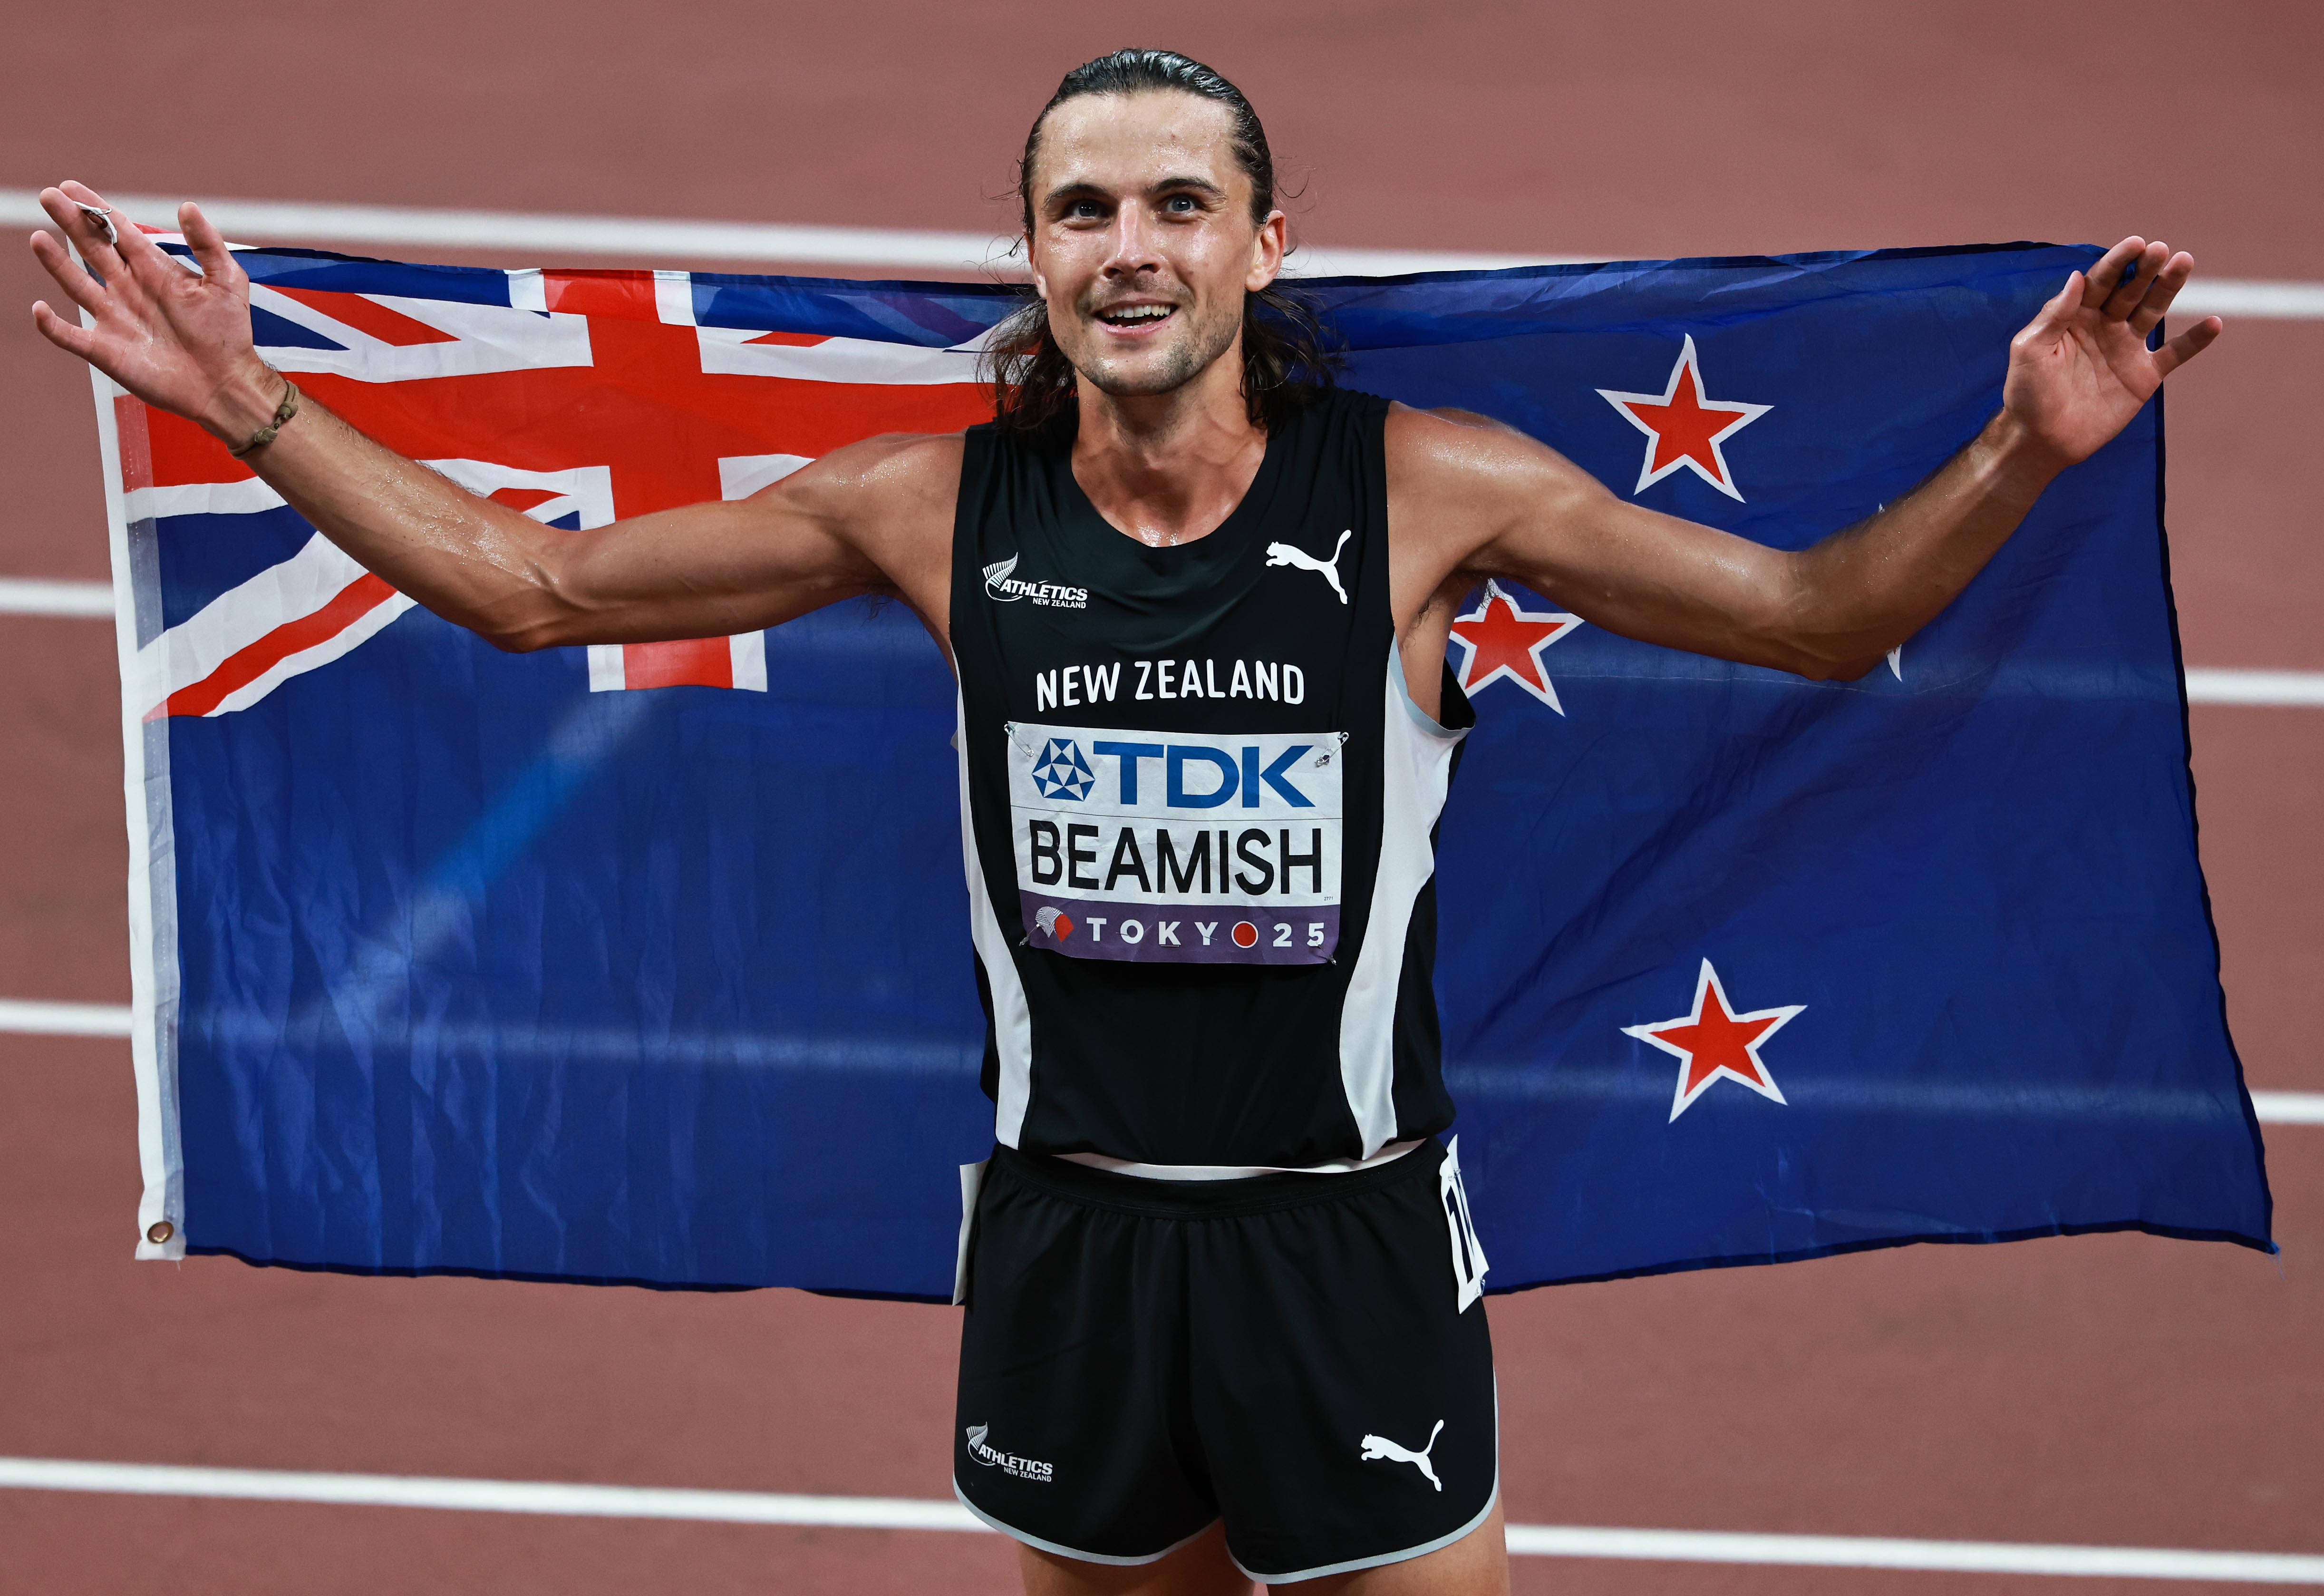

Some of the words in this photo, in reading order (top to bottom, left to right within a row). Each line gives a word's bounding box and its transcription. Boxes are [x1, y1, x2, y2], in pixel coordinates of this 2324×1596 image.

[999, 579, 1088, 601] ATHLETICS
[1033, 597, 1050, 605] NEW
[1051, 599, 1086, 609] ZEALAND
[1036, 662, 1121, 712] NEW
[1134, 659, 1304, 705] ZEALAND
[1093, 740, 1316, 808] TDK
[1029, 819, 1322, 895] BEAMISH
[1273, 922, 1325, 947] 25
[978, 1444, 1053, 1475] ATHLETICS
[1004, 1466, 1018, 1476] NEW
[1020, 1470, 1052, 1482] ZEALAND
